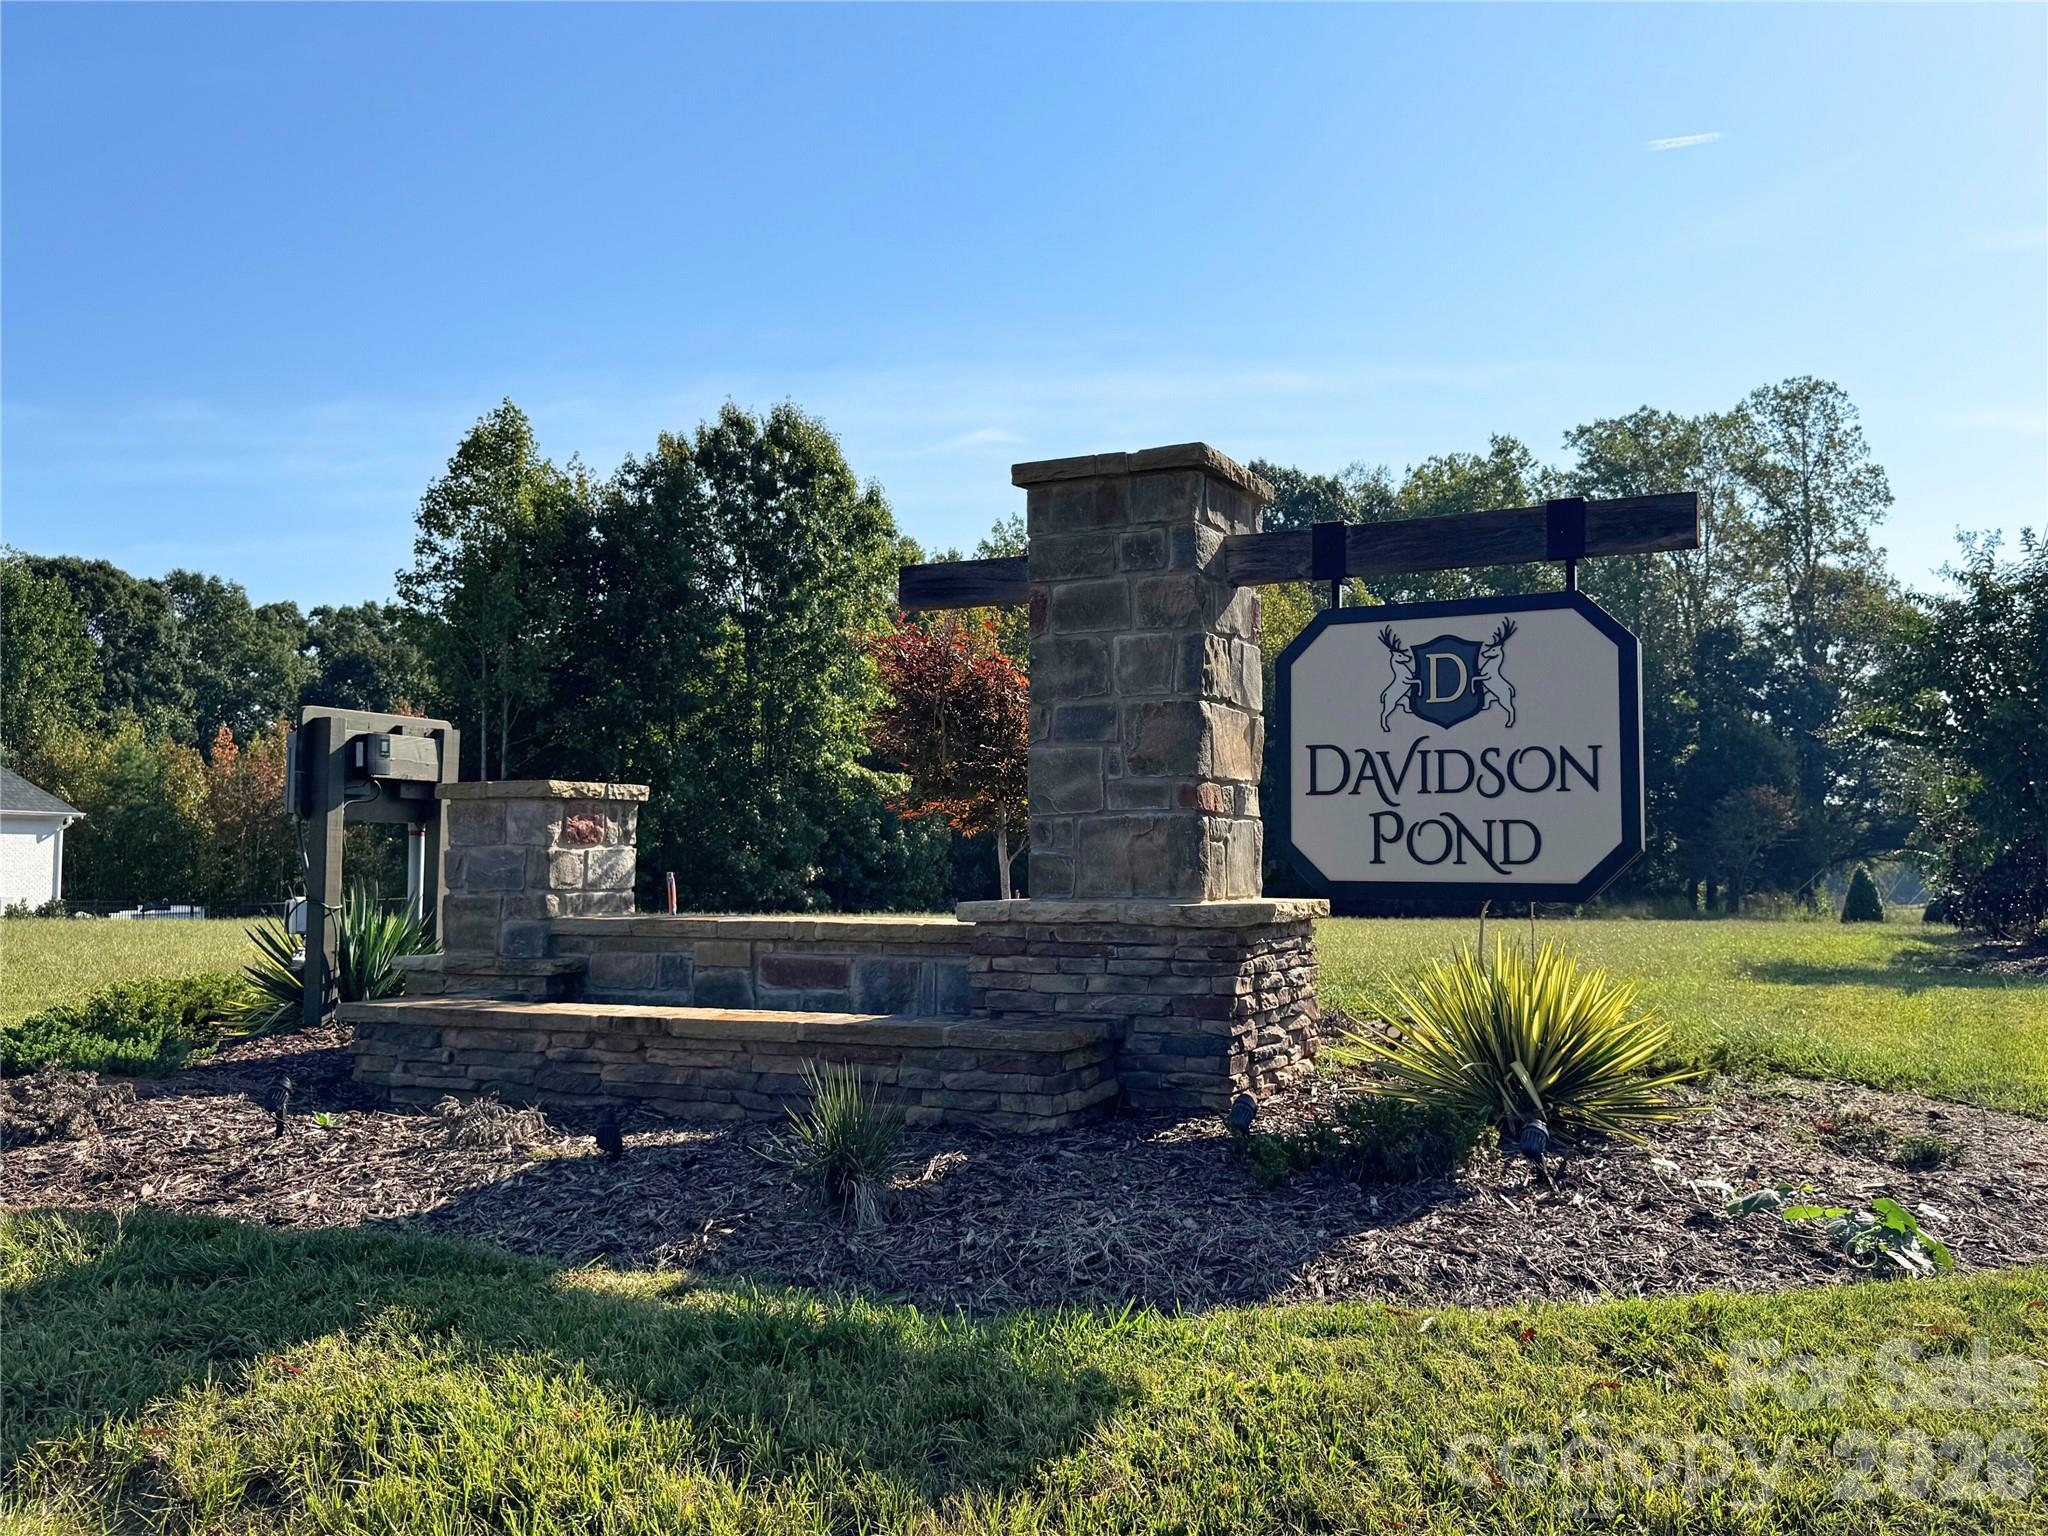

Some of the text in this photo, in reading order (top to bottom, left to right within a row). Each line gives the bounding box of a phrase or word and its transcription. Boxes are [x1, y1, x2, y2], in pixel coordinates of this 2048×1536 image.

[1425, 653, 1468, 704] D
[1305, 735, 1603, 806] DAVIDSON
[1369, 811, 1542, 874] POND
